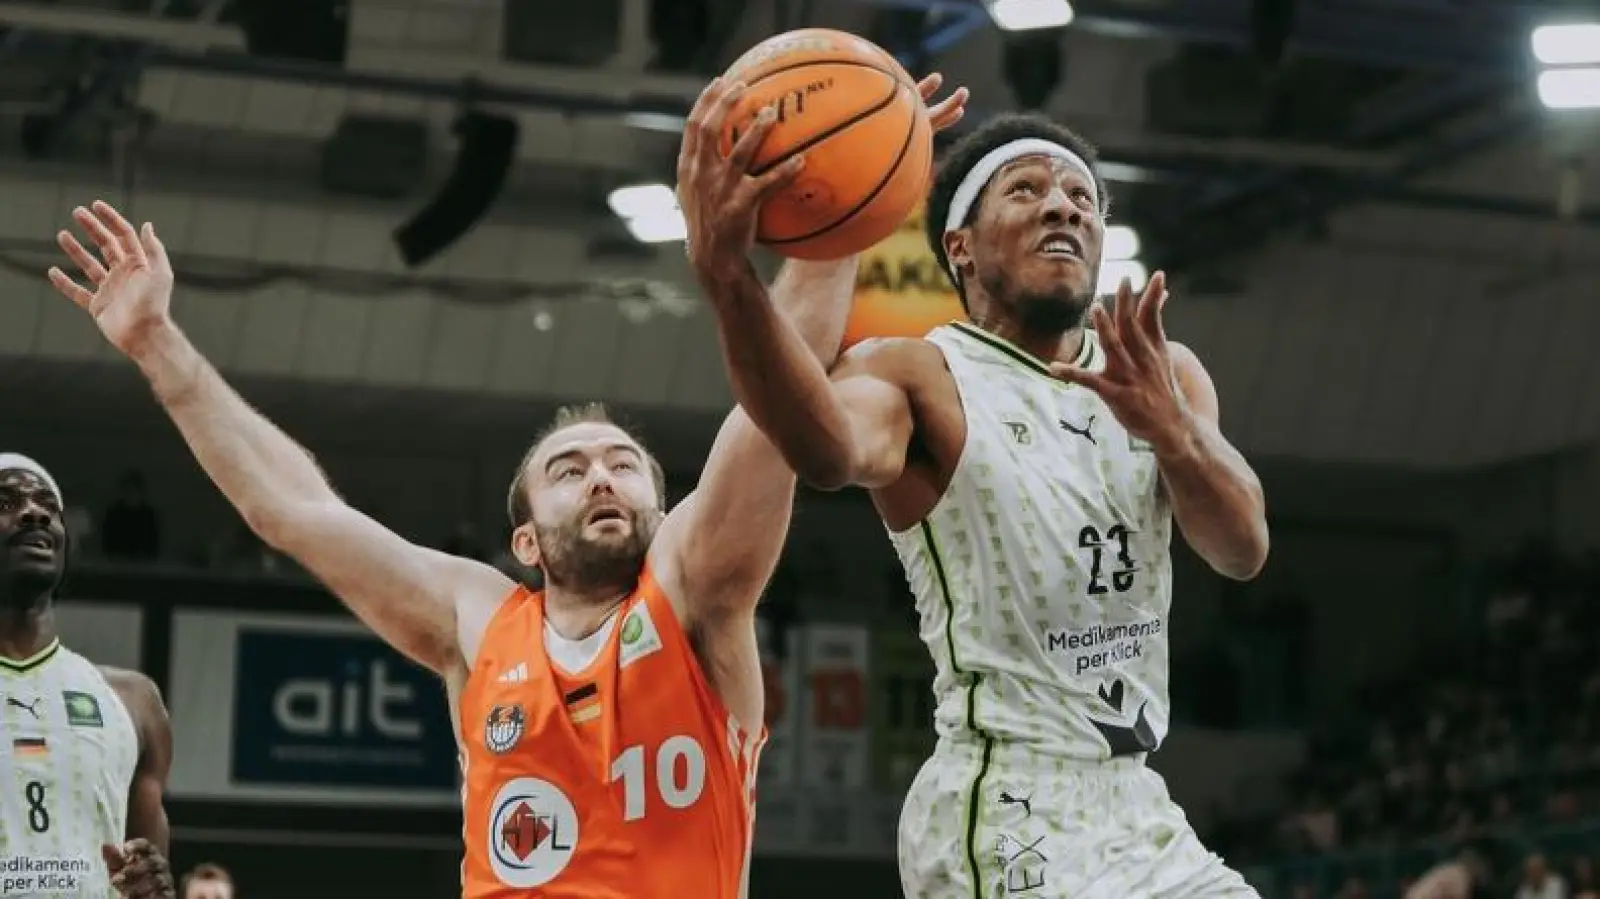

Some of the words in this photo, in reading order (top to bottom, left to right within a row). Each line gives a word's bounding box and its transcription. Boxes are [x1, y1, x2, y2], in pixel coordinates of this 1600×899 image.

[1078, 524, 1141, 595] 23
[1048, 617, 1162, 651] Medikamente
[1076, 650, 1109, 676] per
[273, 659, 424, 739] ait
[611, 735, 706, 822] 10
[26, 781, 50, 833] 8
[3, 877, 33, 894] per
